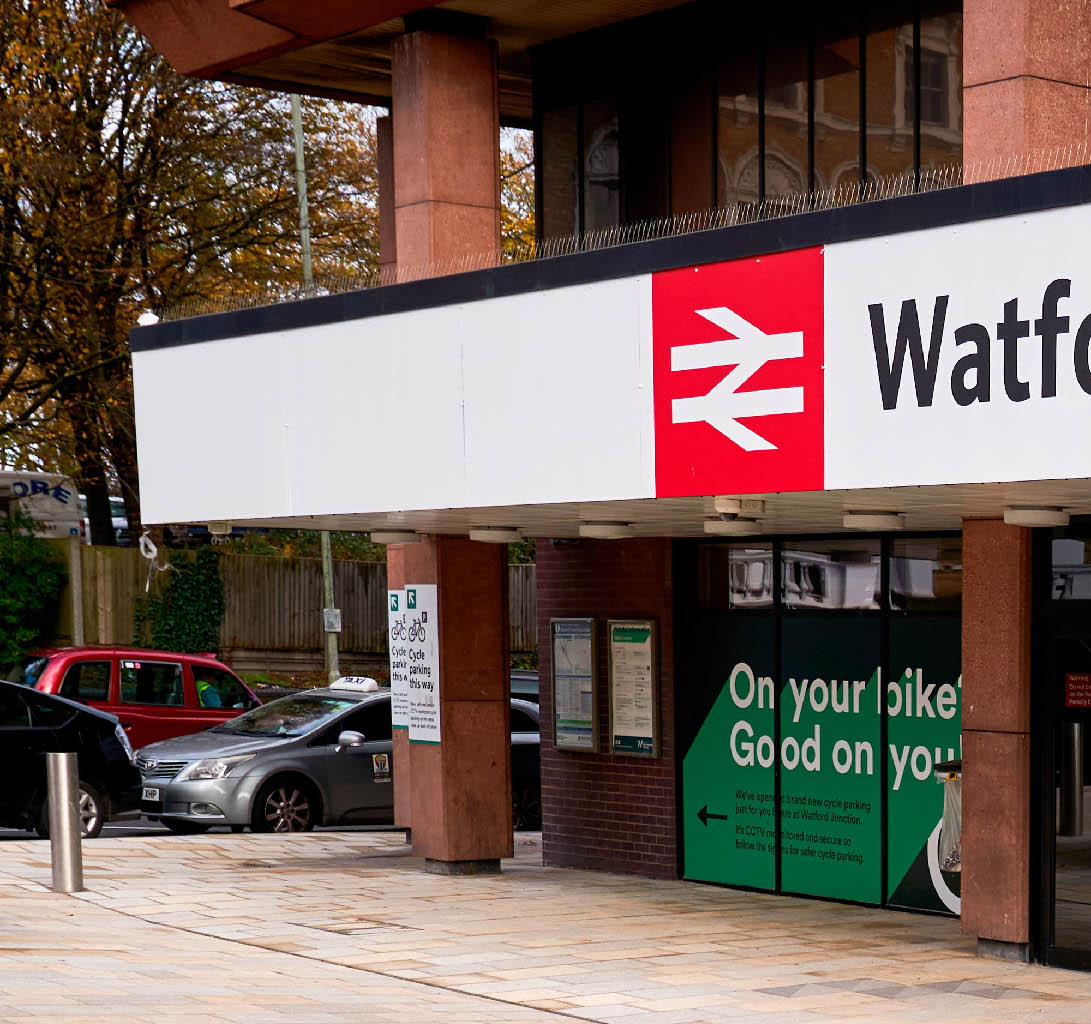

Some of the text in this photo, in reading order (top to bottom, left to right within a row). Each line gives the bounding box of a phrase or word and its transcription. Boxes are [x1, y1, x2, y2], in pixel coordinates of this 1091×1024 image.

[409, 648, 425, 662] Cycle
[410, 664, 431, 677] parking
[410, 678, 434, 692] this way
[729, 662, 775, 709] On
[789, 677, 866, 723] your
[730, 720, 821, 772] Good
[832, 739, 873, 775] on
[843, 800, 871, 813] parking
